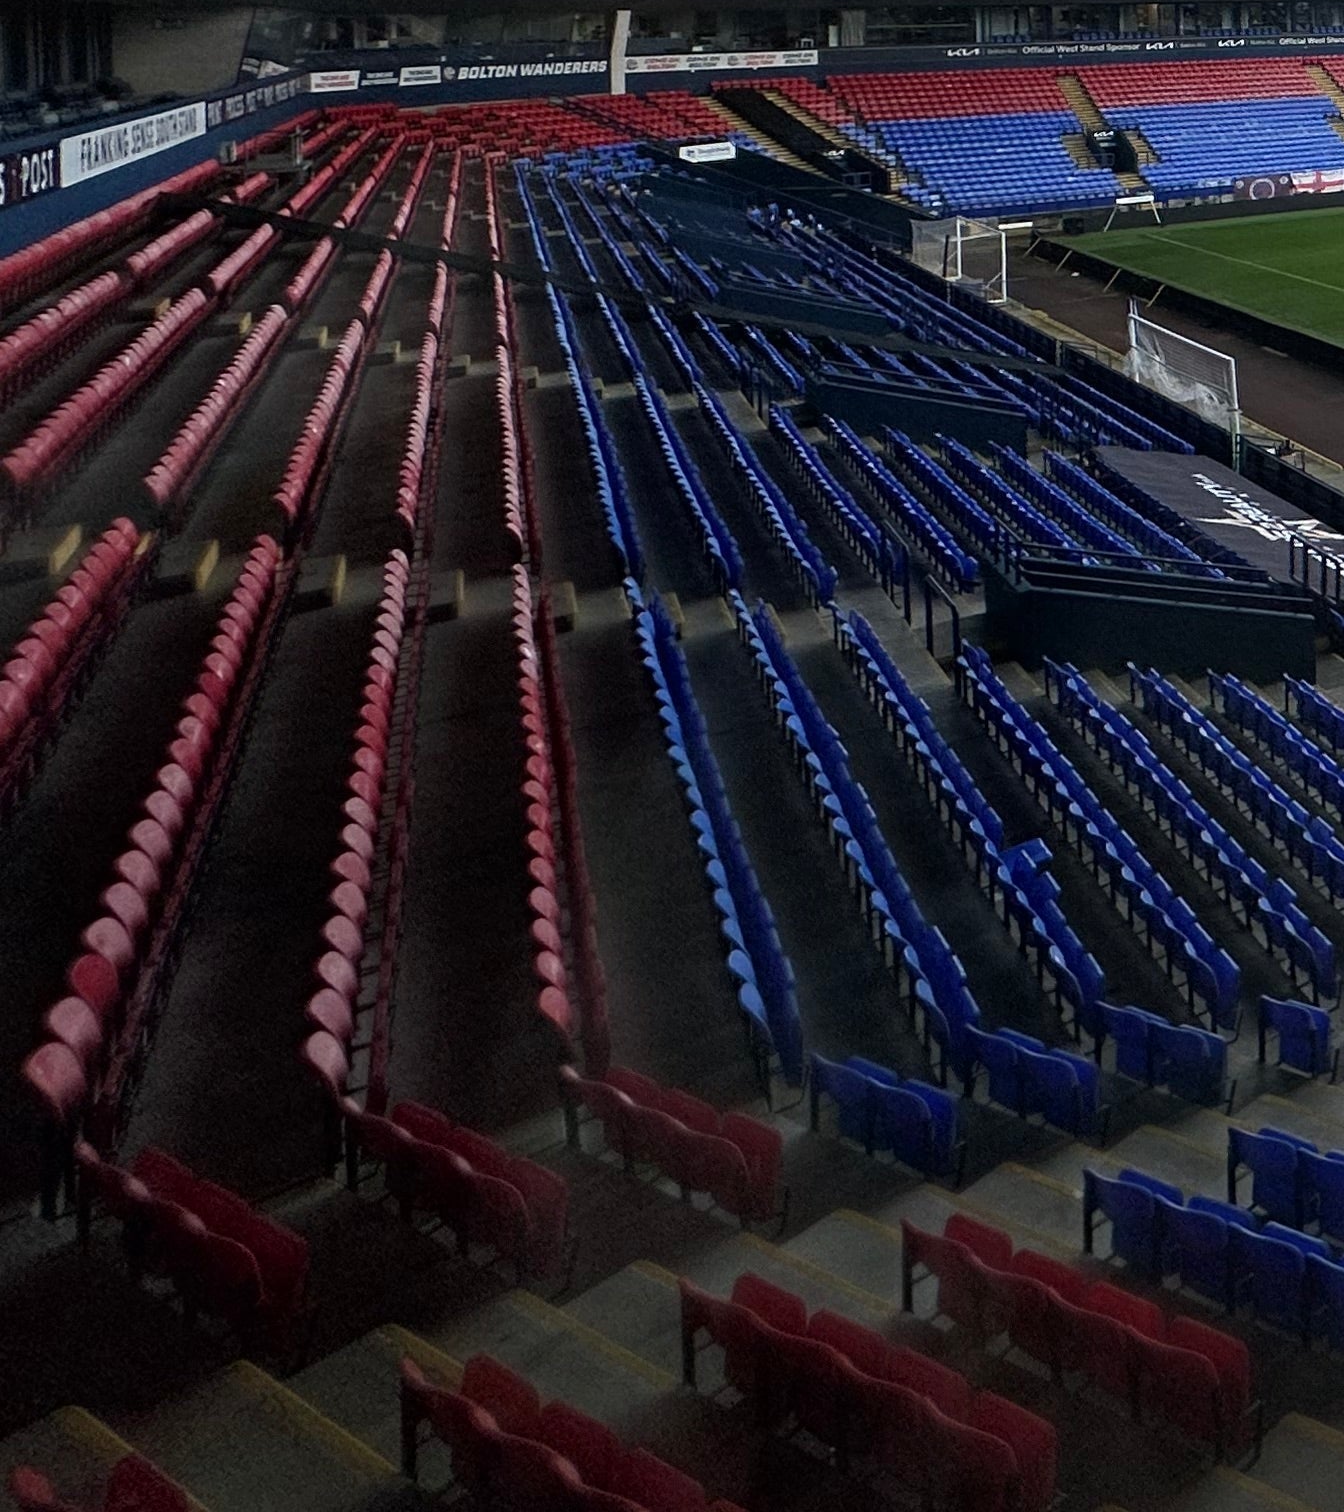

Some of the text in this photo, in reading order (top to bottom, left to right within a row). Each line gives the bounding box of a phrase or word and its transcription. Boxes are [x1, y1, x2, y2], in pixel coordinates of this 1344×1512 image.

[1022, 45, 1054, 54] Official
[1056, 45, 1078, 54] West
[1079, 44, 1105, 53] Stand
[1106, 43, 1141, 53] Sponsor
[458, 60, 608, 80] BOLTON WANDERERS
[20, 149, 54, 197] POST
